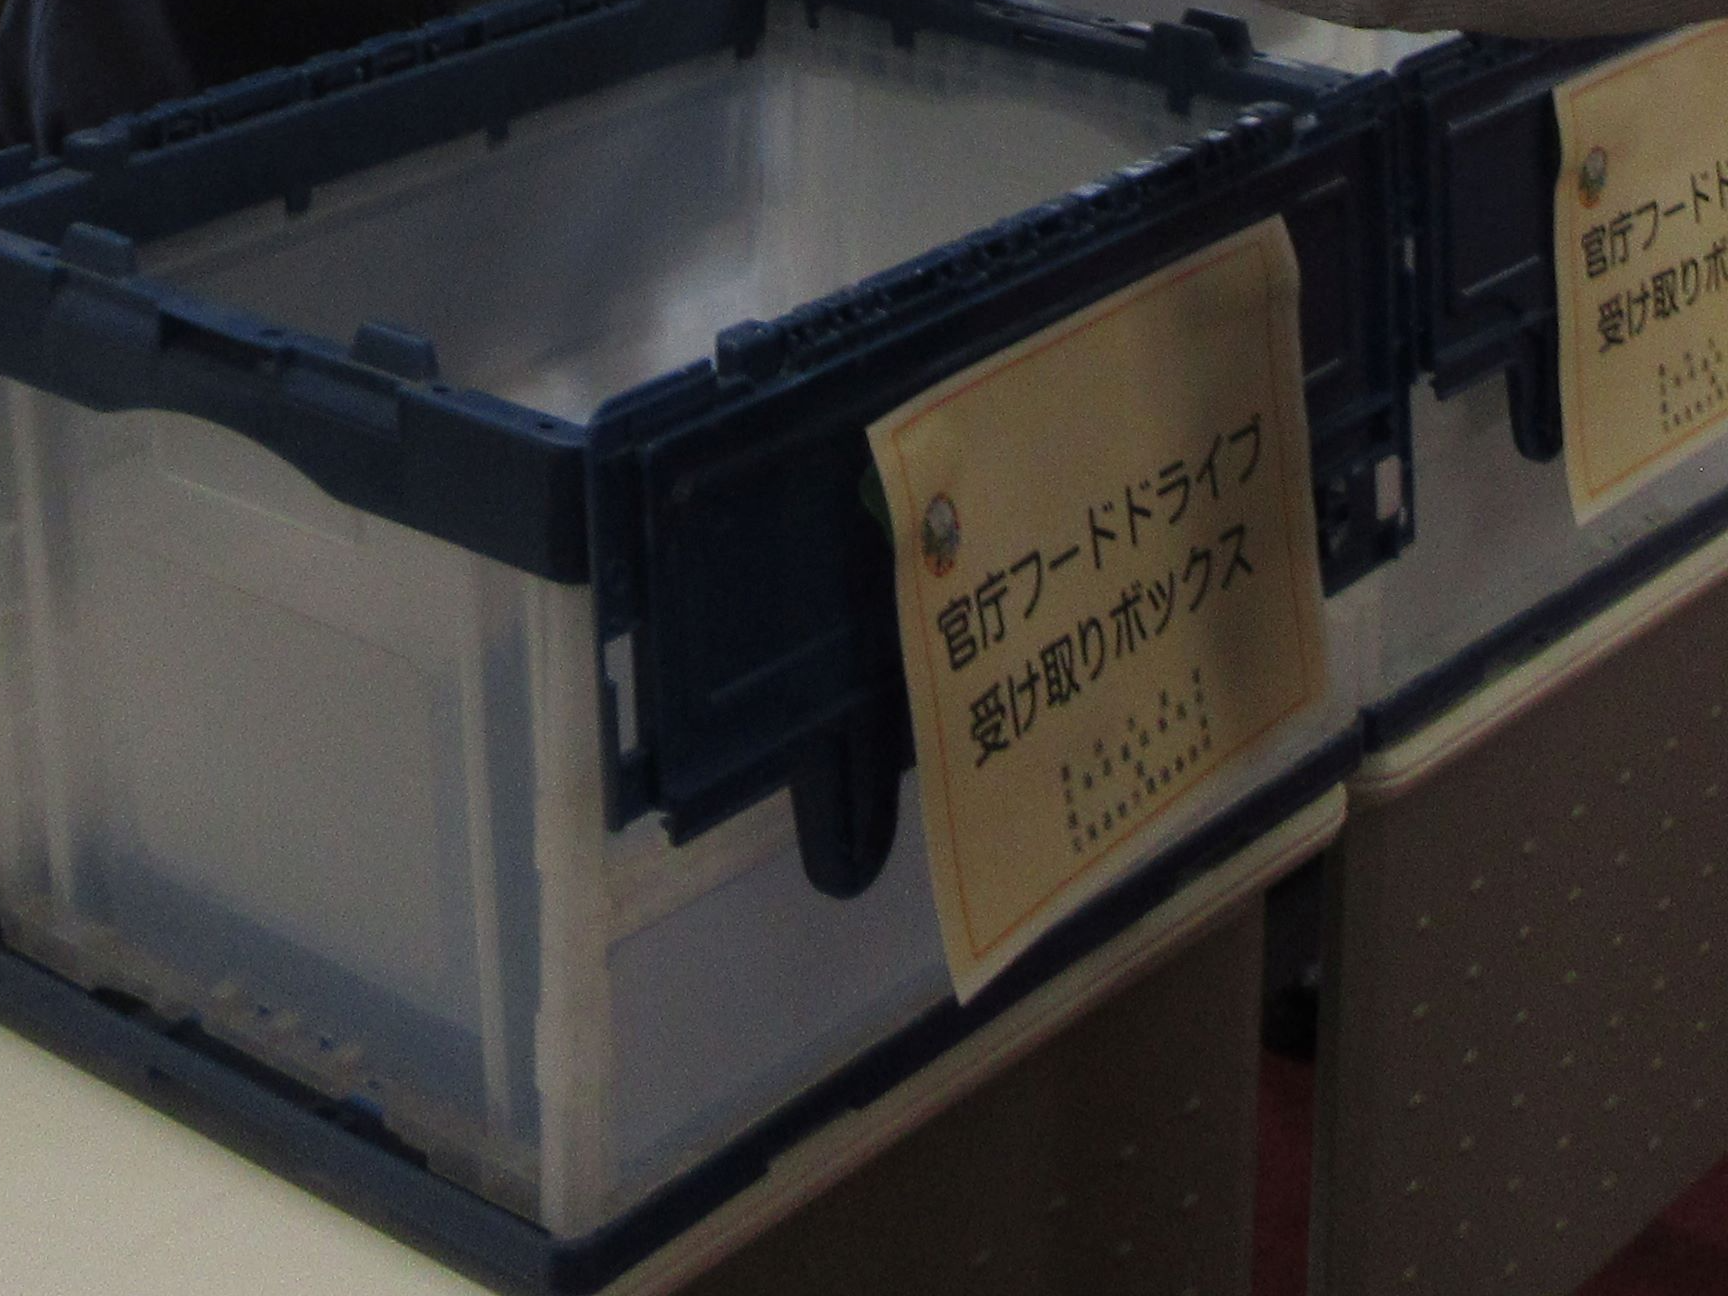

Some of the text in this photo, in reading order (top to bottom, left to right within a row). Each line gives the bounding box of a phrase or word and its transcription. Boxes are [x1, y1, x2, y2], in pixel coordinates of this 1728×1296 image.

[937, 412, 1262, 673] 官庁フードドライブ
[970, 523, 1254, 769] 受け取りボックス
